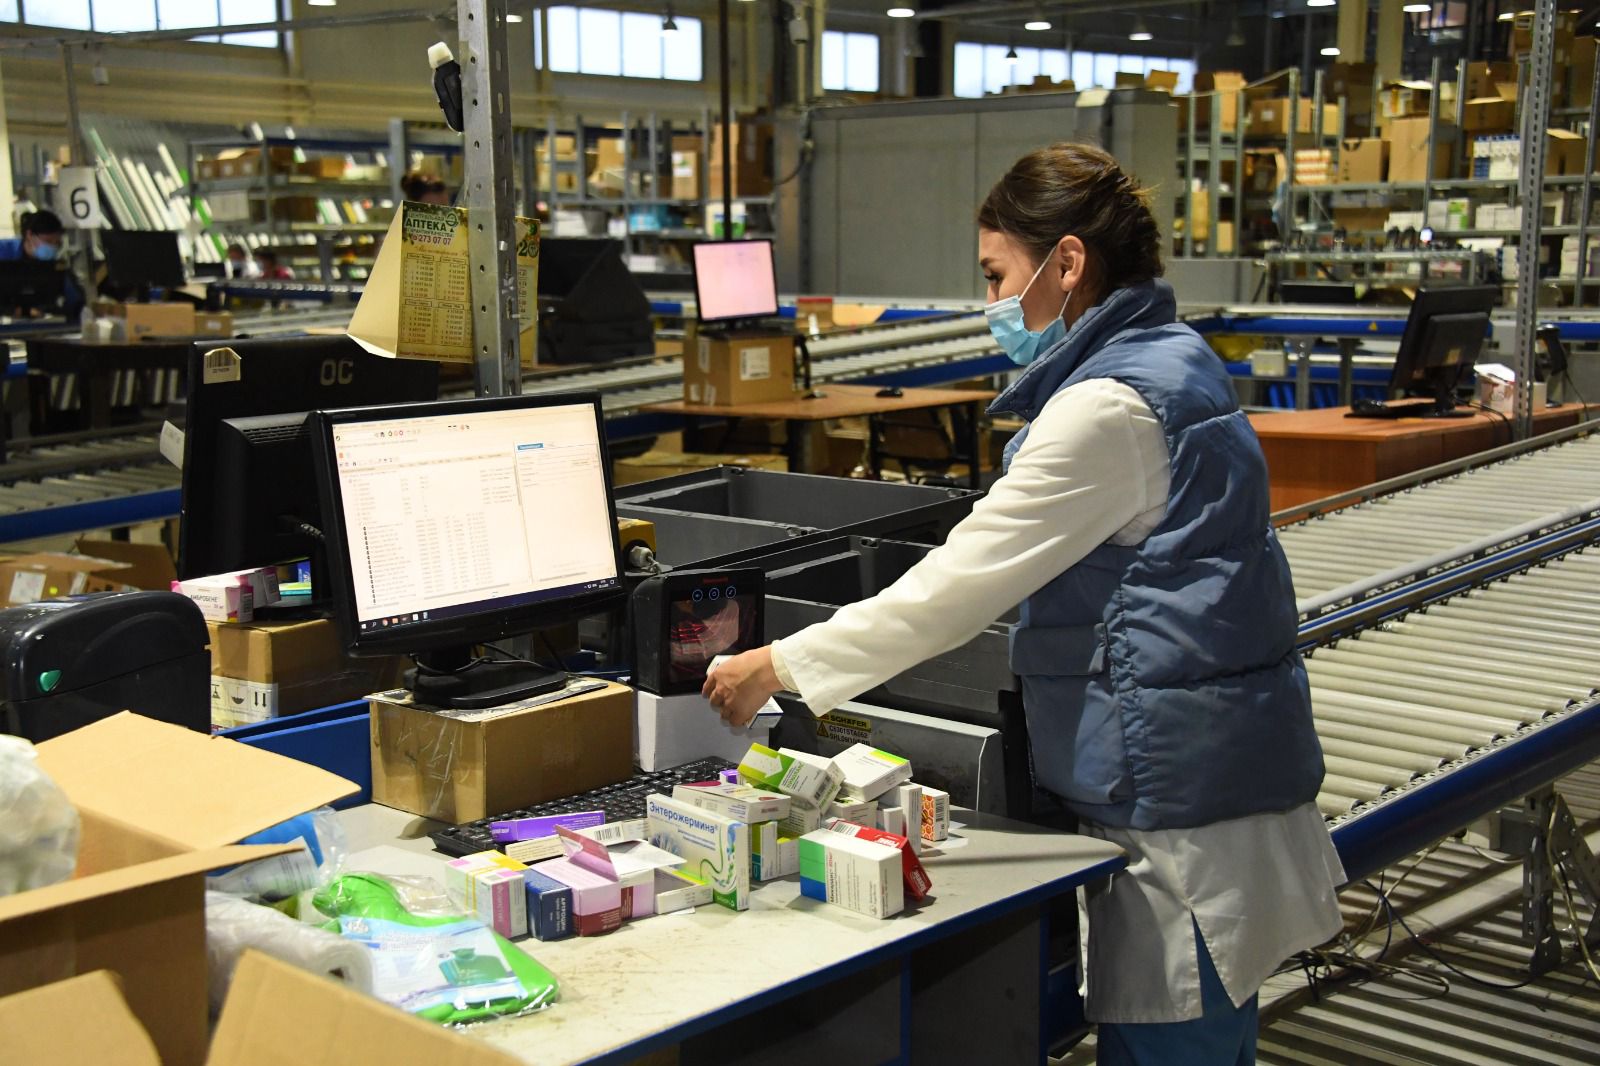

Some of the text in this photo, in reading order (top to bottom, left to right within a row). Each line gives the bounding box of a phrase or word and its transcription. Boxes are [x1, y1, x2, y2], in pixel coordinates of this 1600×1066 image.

[71, 187, 90, 220] 6
[405, 217, 447, 232] АПТЕКА
[419, 235, 432, 243] 273
[432, 236, 442, 244] 07
